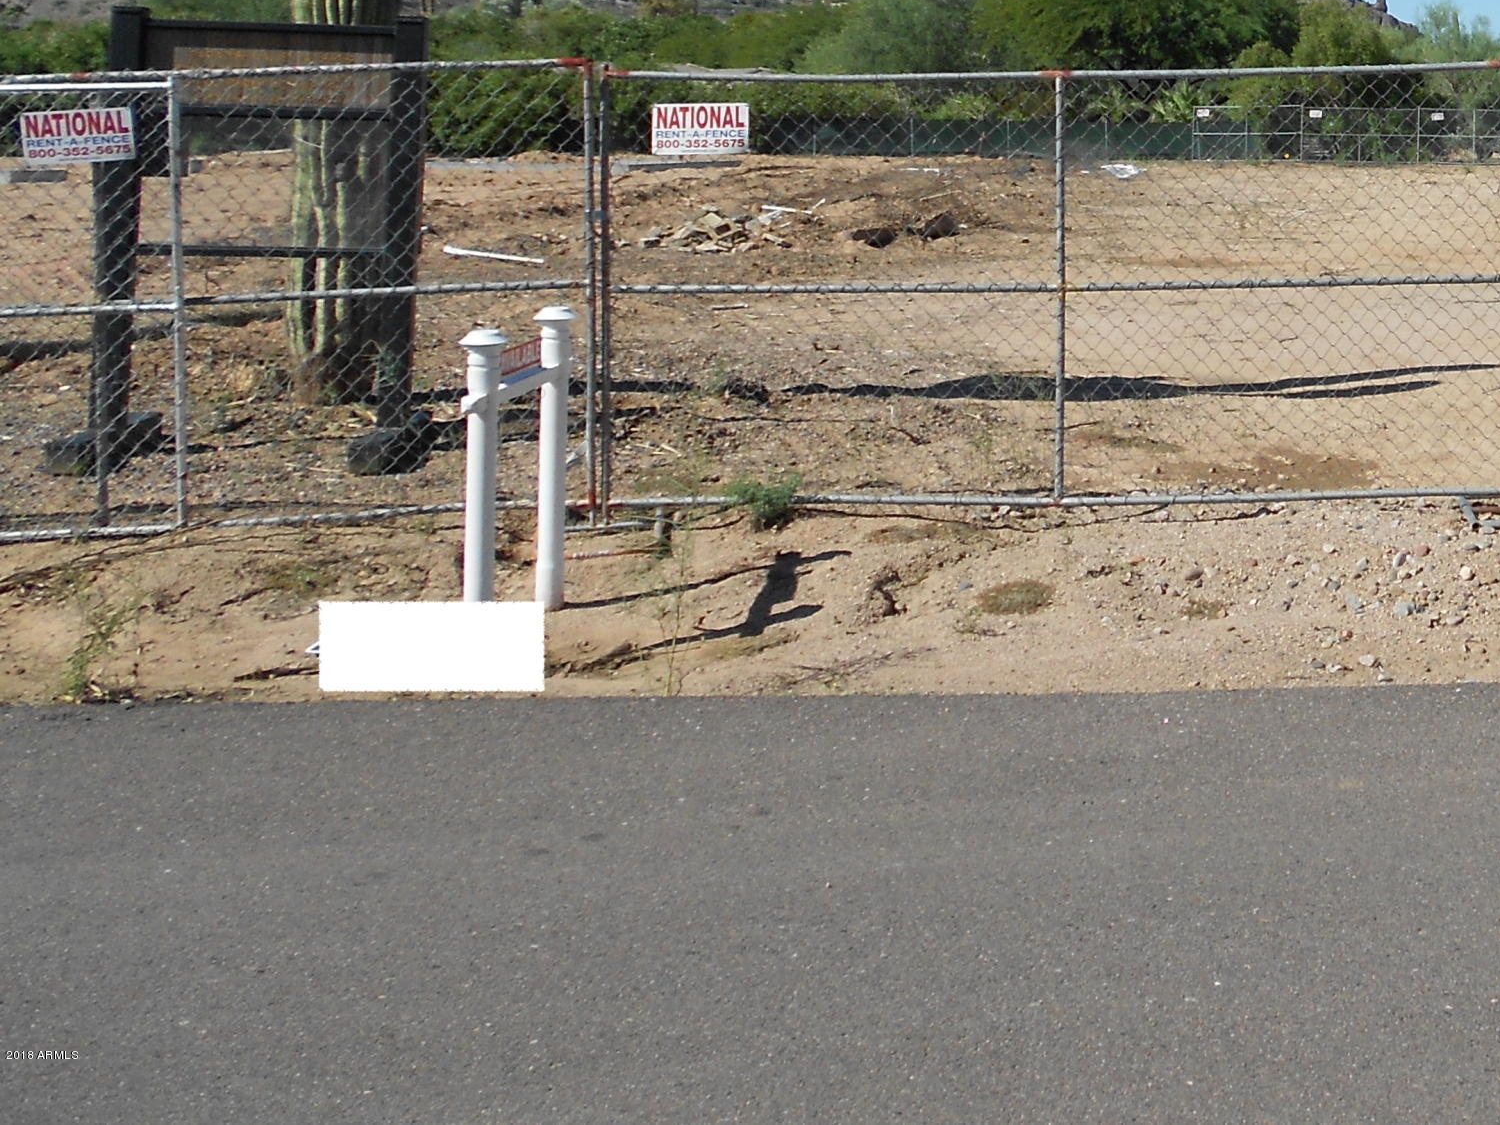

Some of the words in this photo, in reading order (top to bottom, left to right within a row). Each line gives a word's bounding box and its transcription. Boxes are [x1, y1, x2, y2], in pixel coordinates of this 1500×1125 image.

[656, 106, 745, 129] NATIONAL
[24, 111, 129, 138] NATIONAL
[656, 129, 745, 139] RENT-A-FENCE
[27, 135, 130, 148] RENT-A-FENCE
[656, 139, 745, 148] 800-352-5675
[28, 145, 132, 158] 800-352-5675
